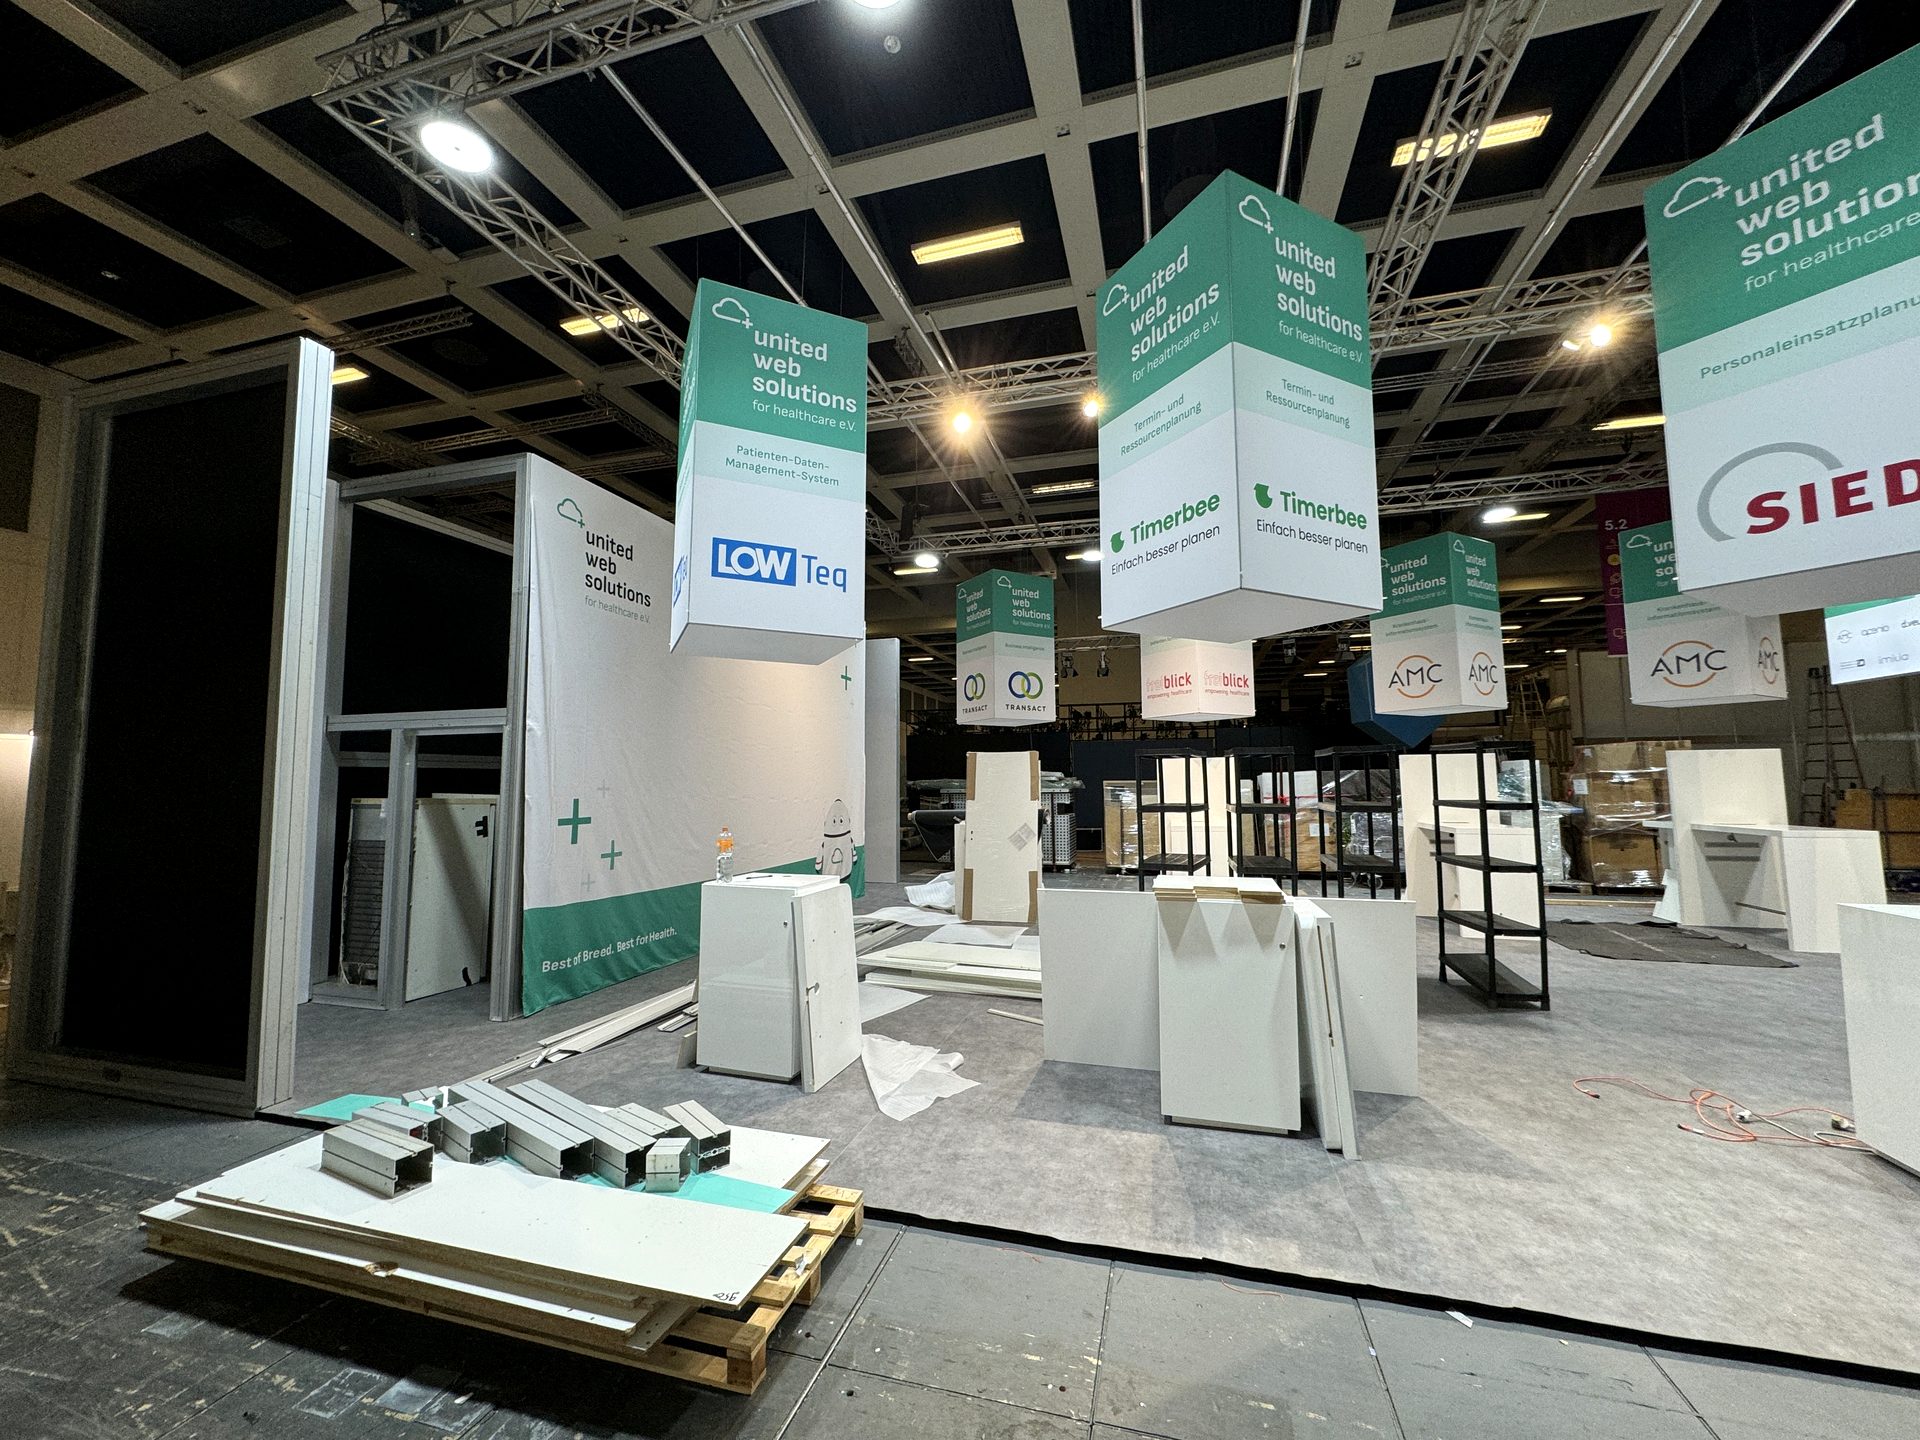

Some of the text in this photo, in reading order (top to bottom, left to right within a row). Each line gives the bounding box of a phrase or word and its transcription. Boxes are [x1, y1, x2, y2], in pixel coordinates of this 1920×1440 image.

[1735, 114, 1884, 206] united
[1736, 180, 1830, 234] web
[1276, 237, 1336, 278] united
[1746, 212, 1920, 291] for healthcare
[1131, 246, 1188, 312] united
[1276, 264, 1316, 296] web
[1131, 295, 1166, 335] web
[1132, 283, 1219, 361] solutions
[1278, 292, 1362, 341] solutions
[754, 330, 828, 362] united
[1132, 314, 1220, 382] for healthcare e.V.
[1279, 321, 1363, 363] for healthcare e.V.
[1701, 296, 1920, 378] Personaleinsatzplanu
[753, 353, 801, 377] web
[752, 376, 857, 413] solutions
[1282, 379, 1334, 405] Termin- und
[752, 400, 857, 432] for healthcare e.V.
[1134, 394, 1184, 432] Termin- und
[1266, 390, 1350, 429] Ressourcenplanung
[1121, 402, 1202, 456] Ressourcenplanung
[725, 457, 840, 486] Management-System
[736, 445, 830, 472] Patienten-Daten-
[1280, 490, 1367, 530] Timerbee
[1746, 459, 1920, 534] SIED
[1131, 494, 1220, 544] Timerbee
[1604, 519, 1628, 530] 5.2
[586, 530, 633, 561] united
[1111, 526, 1220, 575] Einfach besser planen
[1256, 520, 1368, 554] Einfach besser planen
[586, 552, 616, 575] web
[802, 554, 848, 592] Teq
[1390, 555, 1427, 573] united
[1465, 554, 1486, 567] united
[1466, 567, 1480, 577] web
[585, 574, 651, 607] solutions
[1012, 588, 1039, 598] united
[1391, 571, 1414, 585] web
[1392, 576, 1446, 596] solutions
[1467, 578, 1496, 592] solutions
[585, 595, 650, 624] for healthcare e.V.
[966, 588, 984, 603] united
[966, 603, 978, 612] web
[1012, 599, 1030, 608] web
[966, 607, 991, 623] solutions
[1012, 609, 1051, 621] solutions
[1388, 664, 1443, 689] AMC
[1469, 664, 1498, 684] AMC
[1651, 649, 1727, 677] AMC
[1758, 650, 1780, 672] AMC
[962, 704, 988, 714] TRANSACT
[1006, 704, 1046, 712] TRANSACT
[542, 926, 677, 973] Best of Breed. Best for Health.
